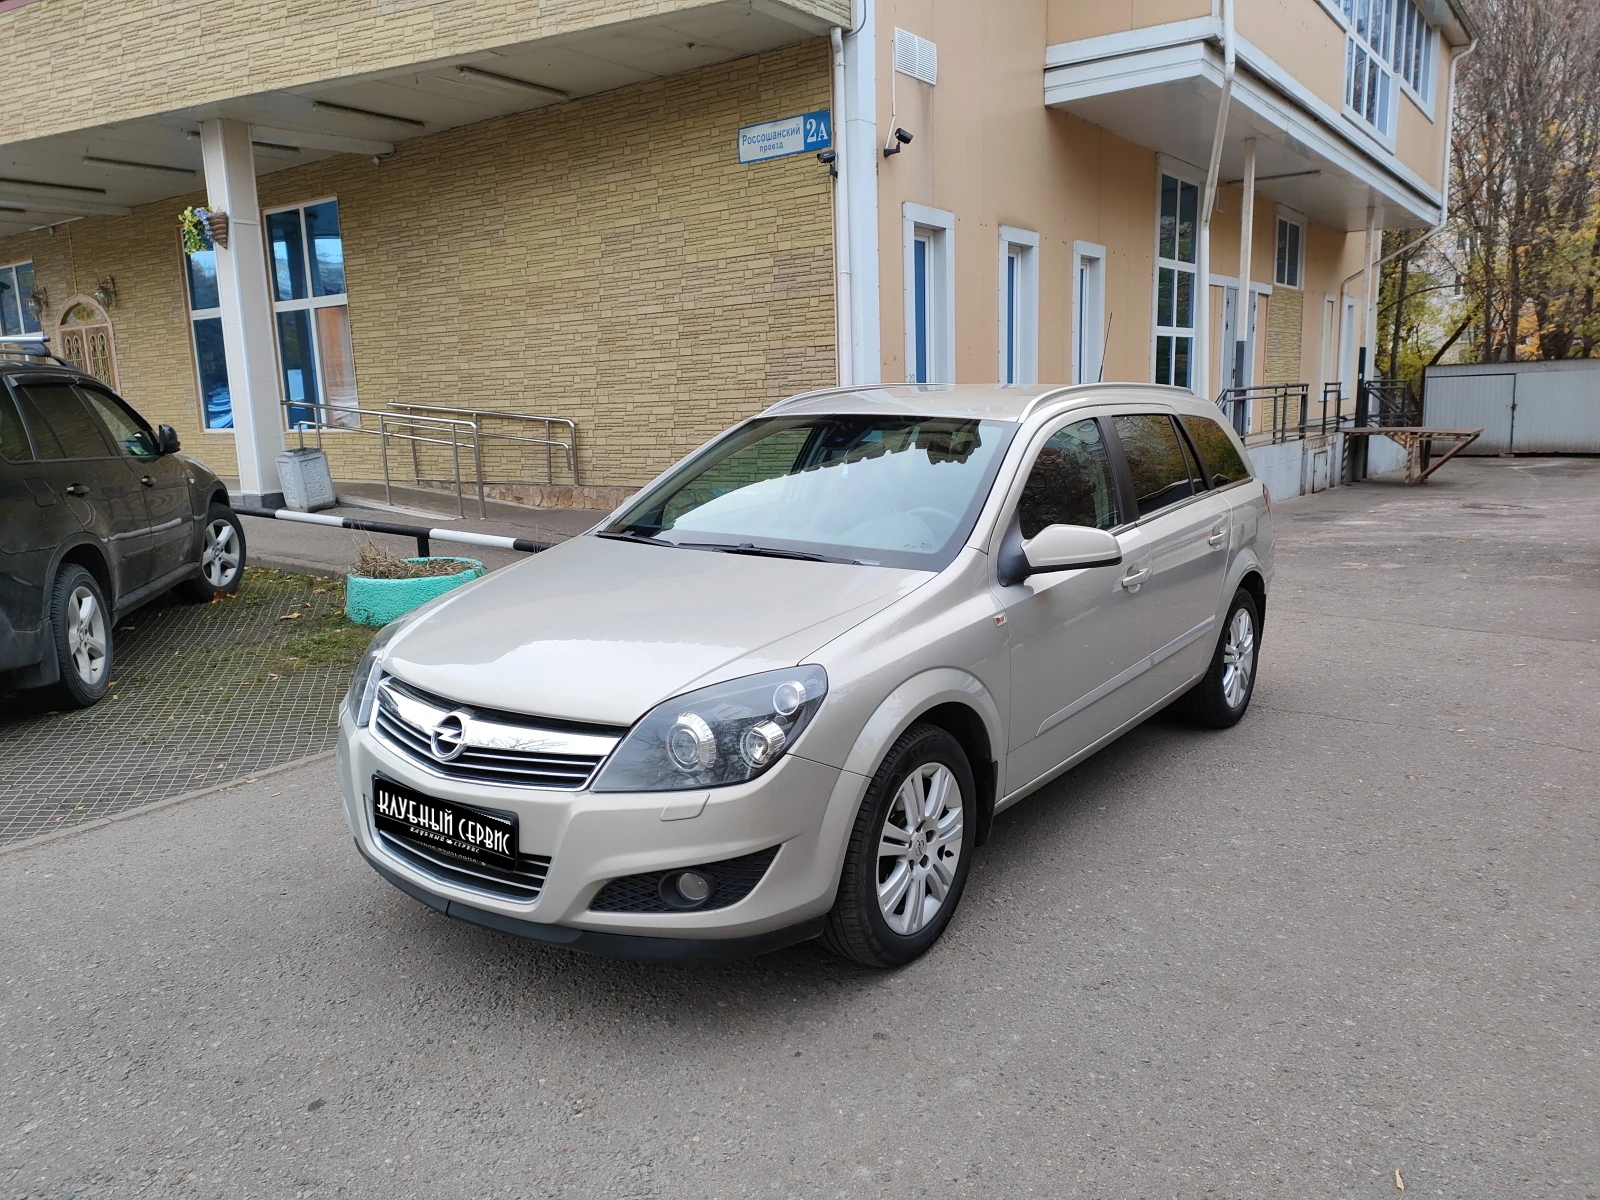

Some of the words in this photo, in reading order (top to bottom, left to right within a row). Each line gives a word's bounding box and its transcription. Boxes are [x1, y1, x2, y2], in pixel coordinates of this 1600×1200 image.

[742, 123, 801, 146] Россошанский
[806, 118, 829, 143] 2А
[759, 141, 784, 153] проезд
